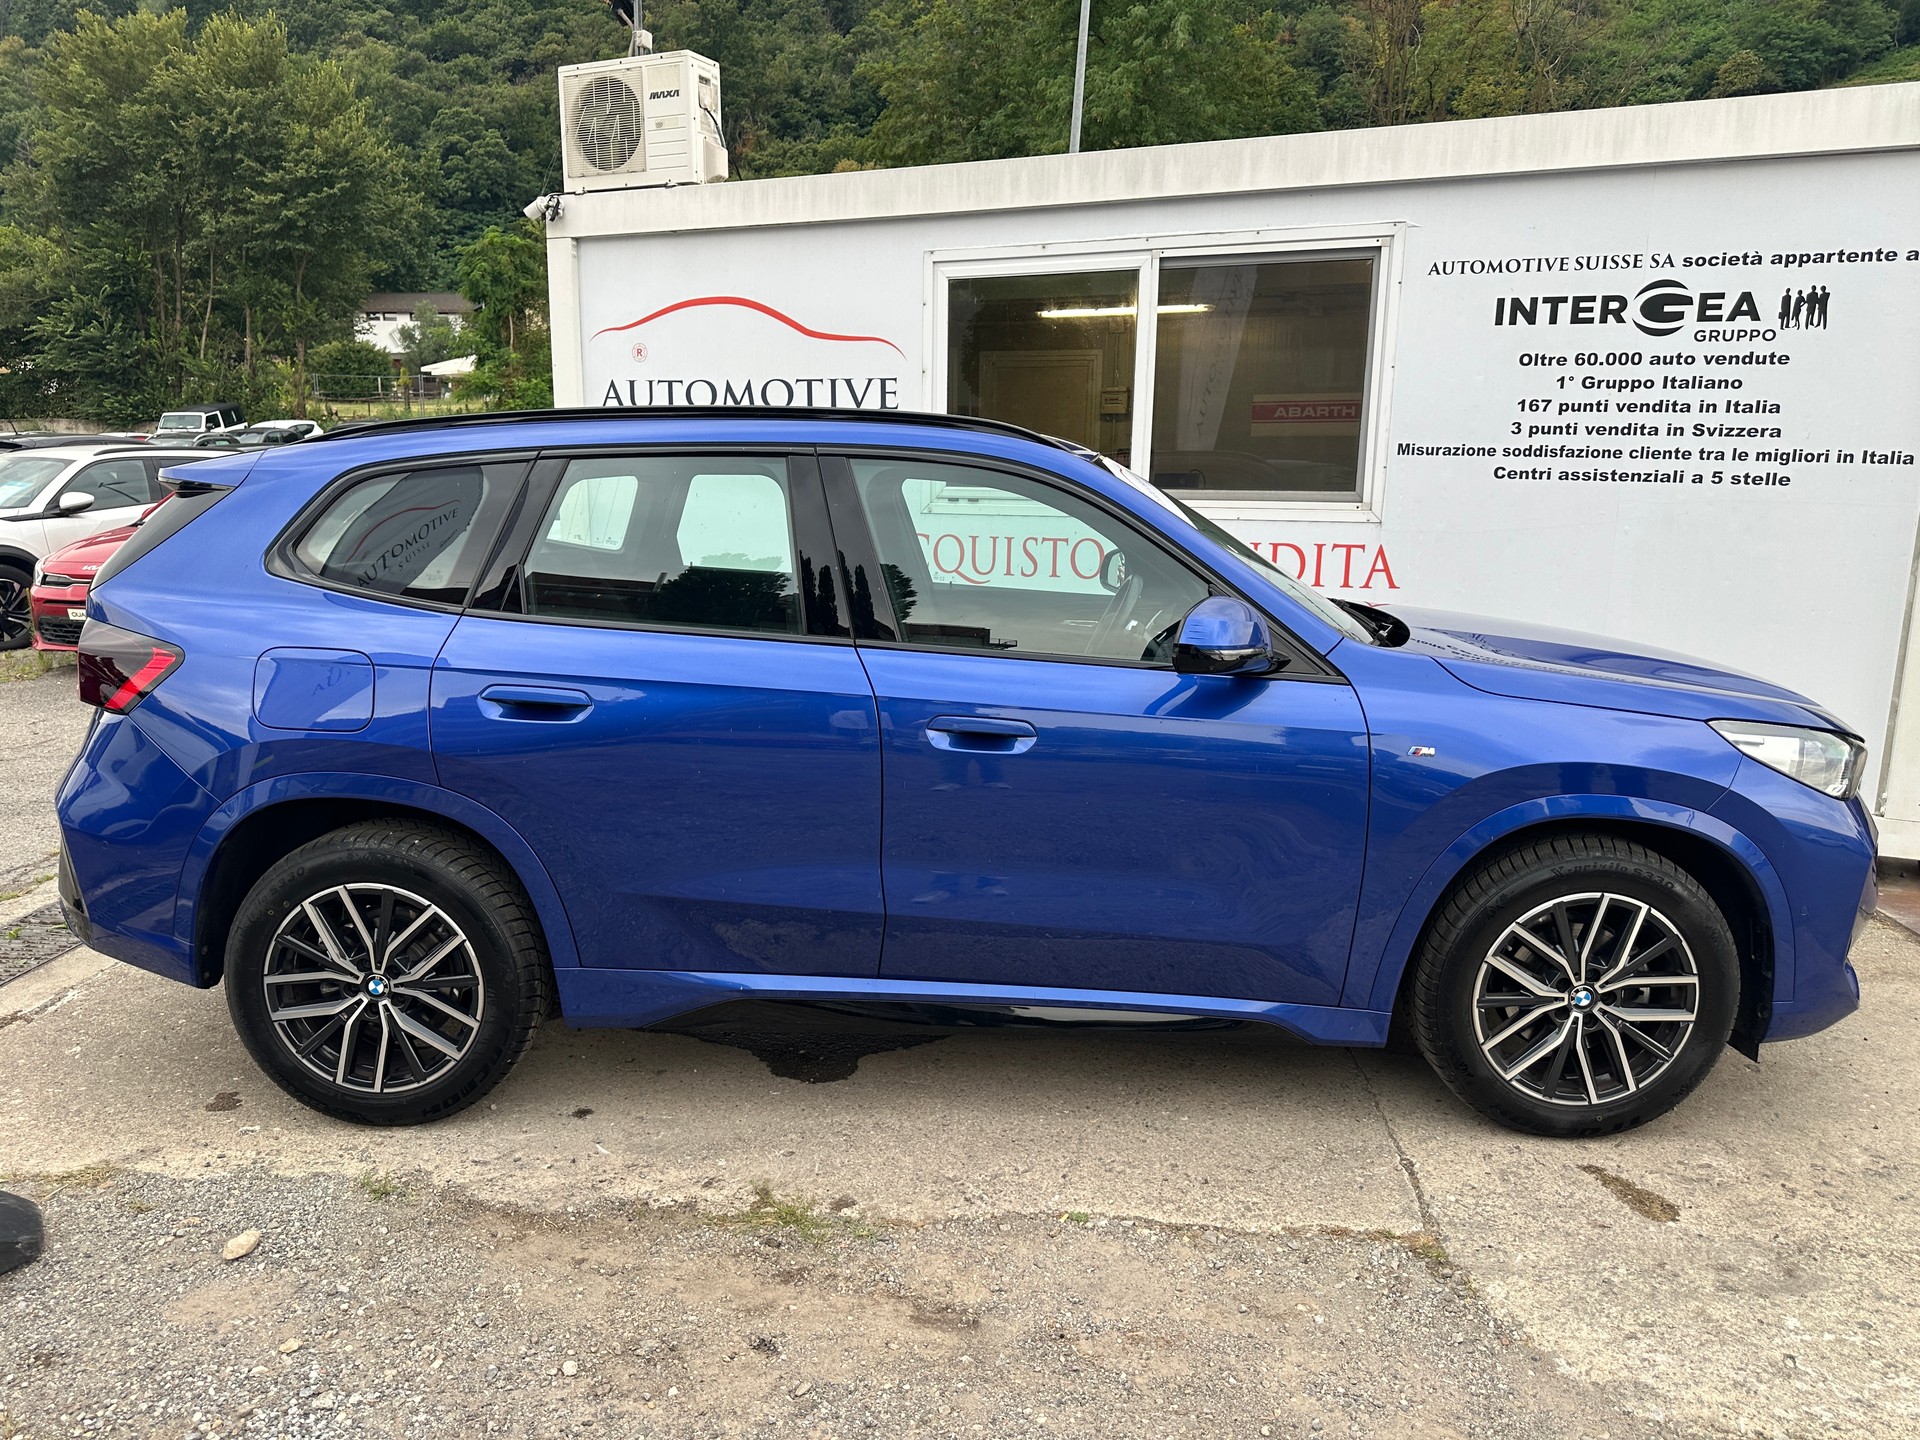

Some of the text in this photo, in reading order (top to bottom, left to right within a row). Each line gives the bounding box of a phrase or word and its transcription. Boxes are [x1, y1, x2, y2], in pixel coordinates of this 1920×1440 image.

[1428, 248, 1919, 275] AUTOMOTIVE SUISSE SA società appartente a
[1494, 281, 1762, 335] INTERGEA
[1694, 329, 1776, 342] GRUPPO
[1519, 351, 1790, 366] Oltre 60.000 auto vendute
[602, 377, 899, 409] AUTOMOTIVE
[1557, 376, 1742, 392] 1° Gruppo Italiano
[1273, 405, 1356, 418] ABARTH
[1518, 399, 1780, 415] 167 punti vendita in Italia
[1511, 422, 1781, 438] 3 punti vendita in Svizzera
[1397, 443, 1914, 465] Misurazione soddisfazione cliente tra le migliori in Italia
[1494, 467, 1790, 486] Centri assistenziali a 5 stelle
[357, 507, 459, 587] AUTOMOTIVE
[1250, 542, 1401, 589] DITA
